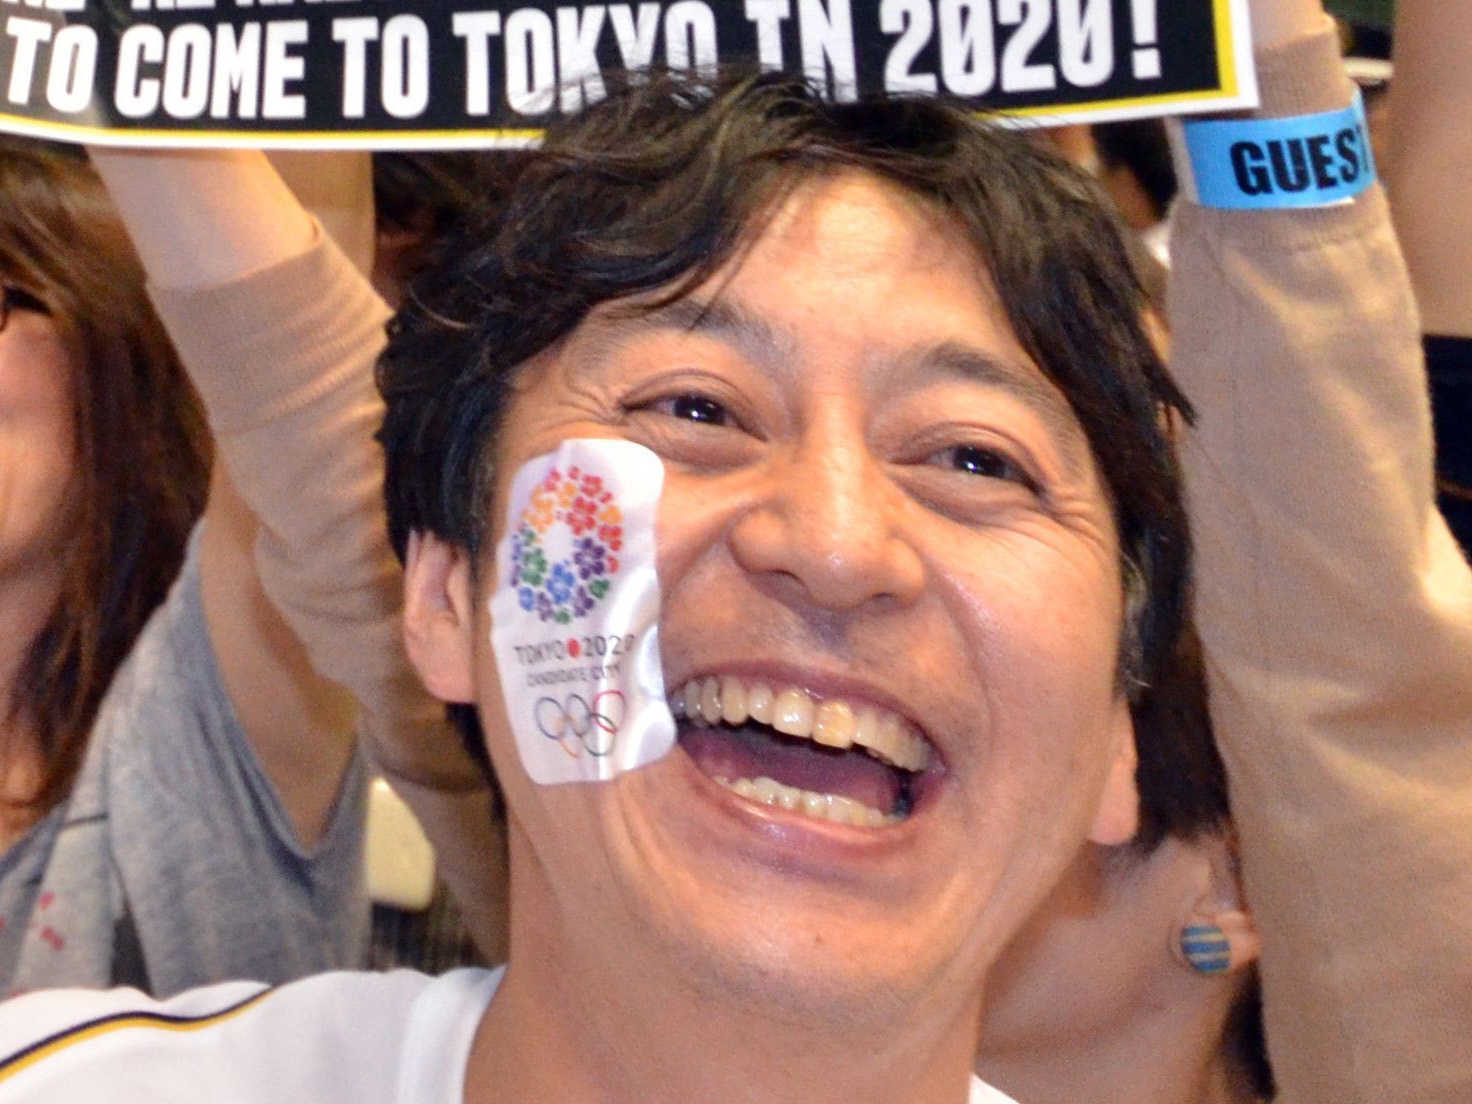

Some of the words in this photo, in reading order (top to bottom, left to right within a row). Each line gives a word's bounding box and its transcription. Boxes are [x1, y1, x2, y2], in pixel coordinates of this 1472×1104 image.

[5, 16, 99, 114] TO
[114, 19, 309, 119] COME
[331, 13, 429, 119] TO
[451, 0, 718, 115] TOKYO
